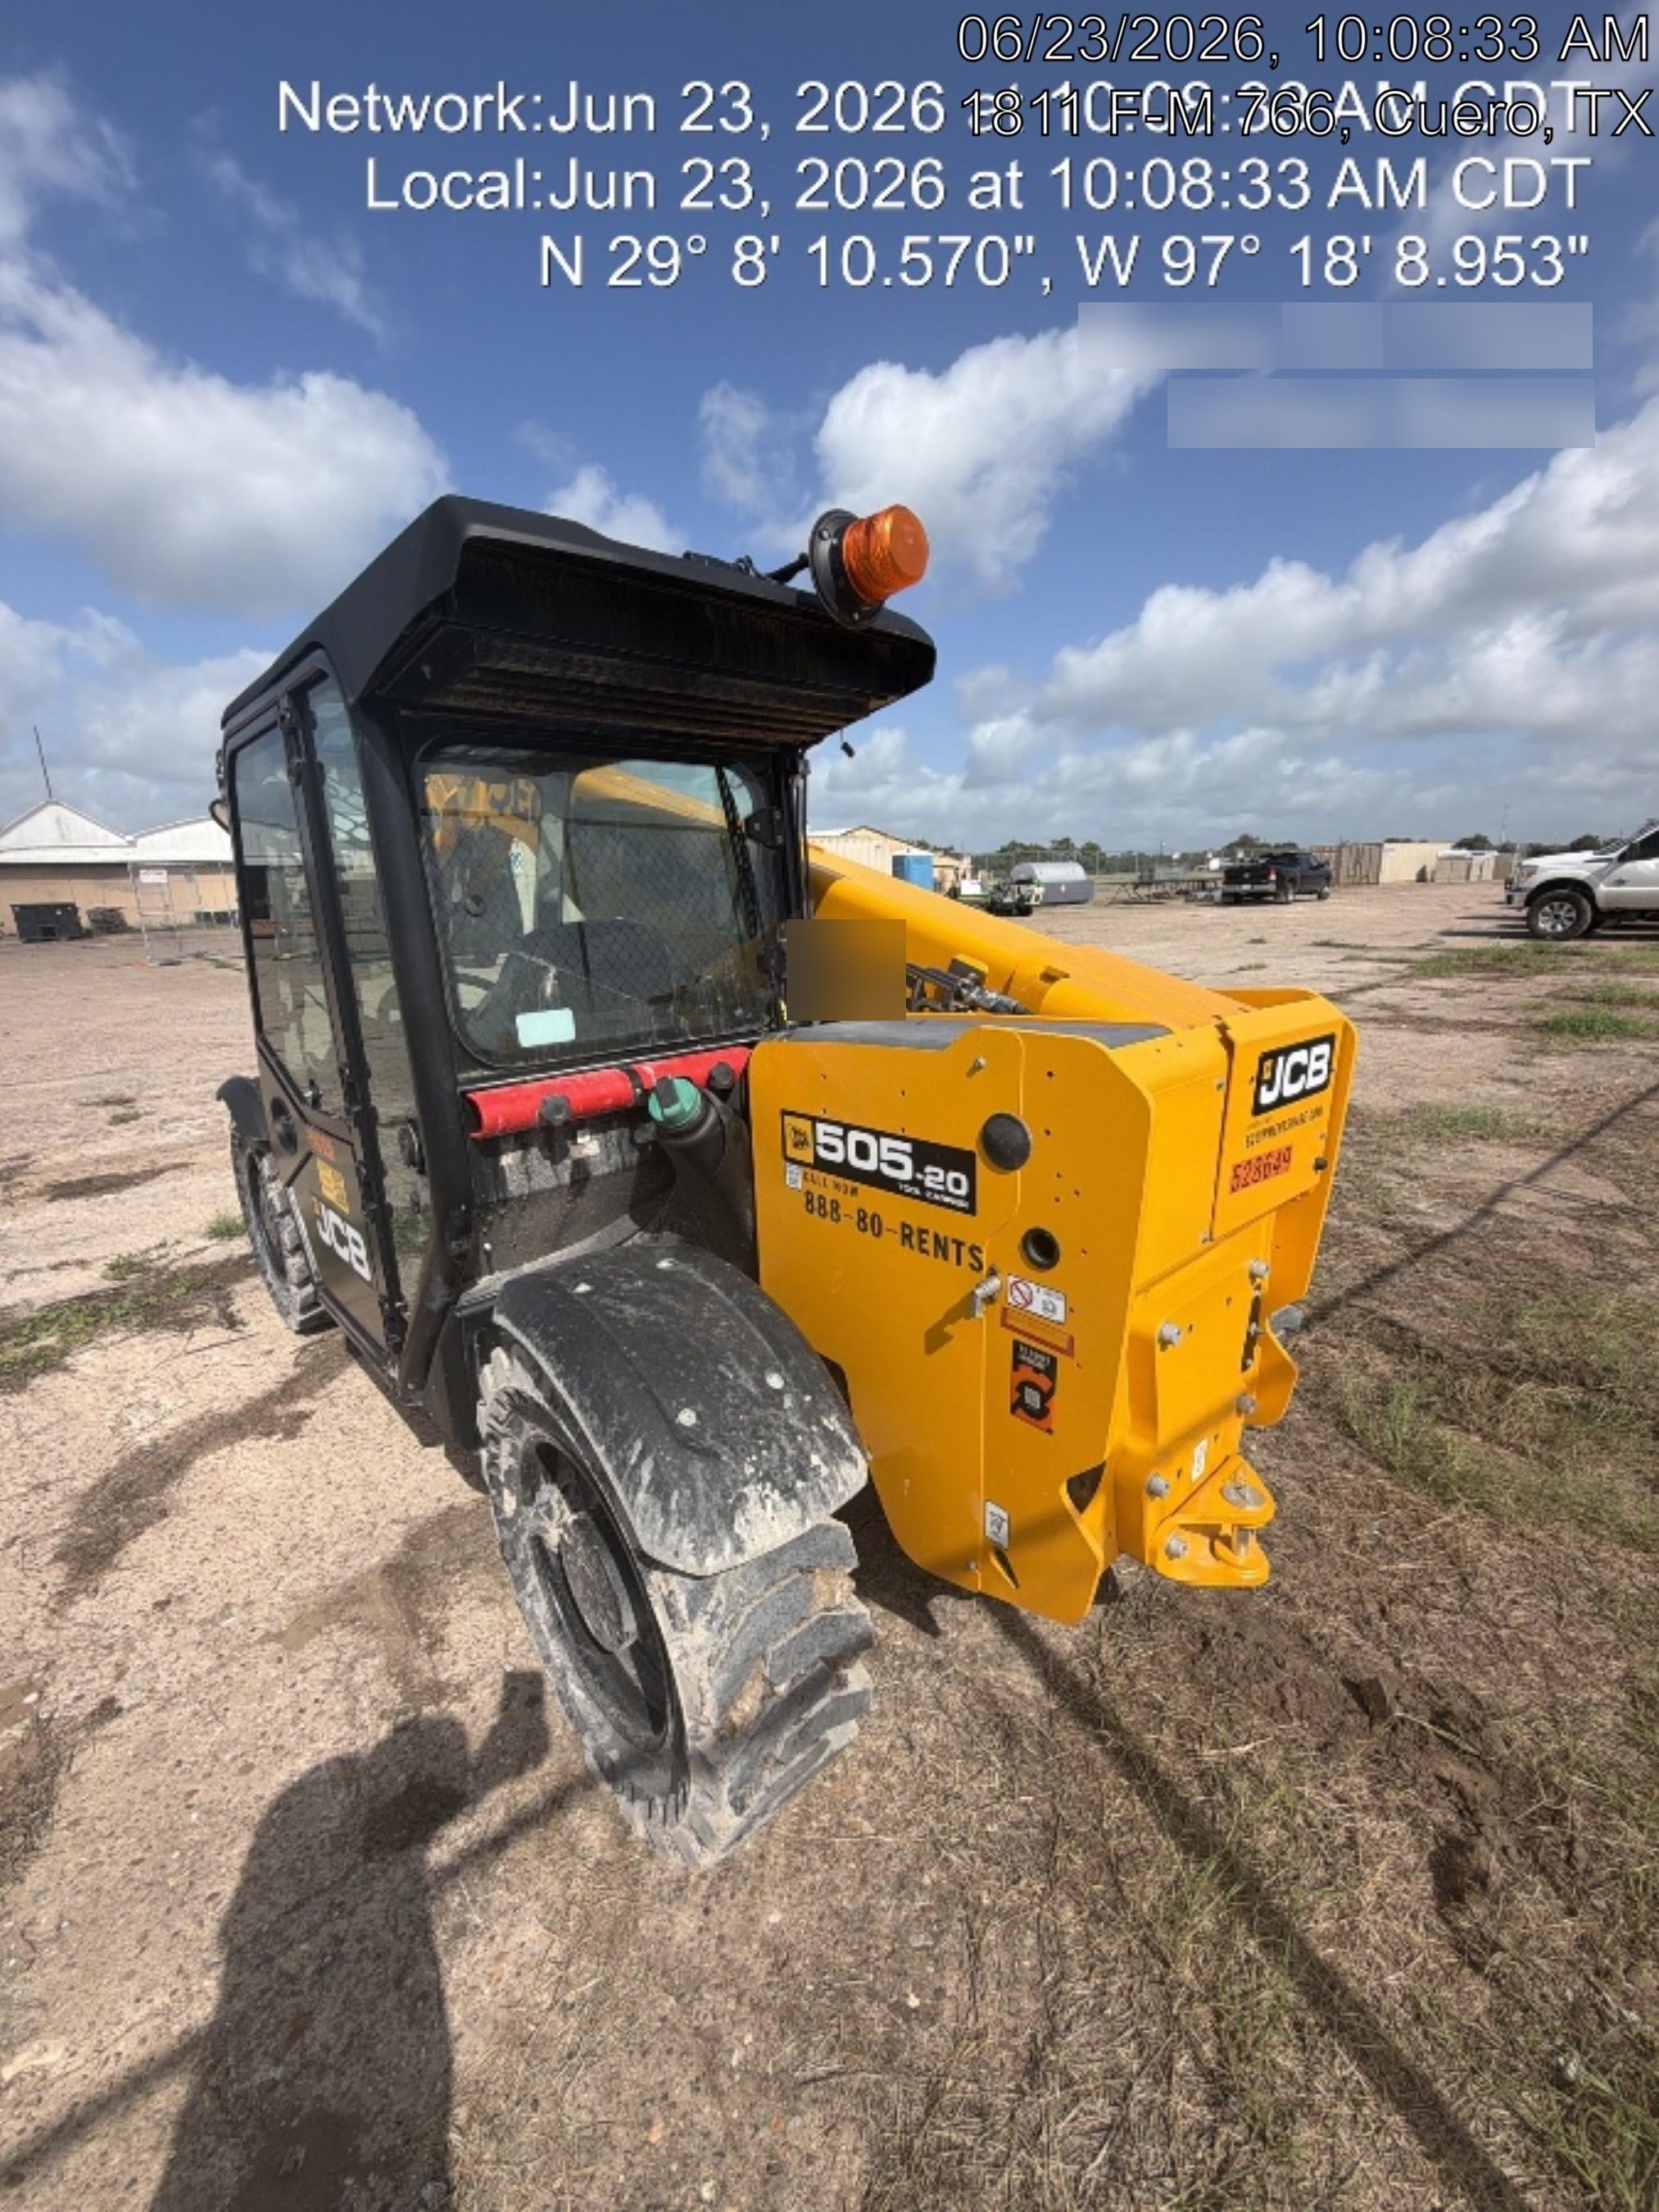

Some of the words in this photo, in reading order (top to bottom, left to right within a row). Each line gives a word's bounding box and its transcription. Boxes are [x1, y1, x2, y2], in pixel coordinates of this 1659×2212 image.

[1259, 1043, 1330, 1105] JCB
[316, 1203, 372, 1281] JCB
[804, 1190, 985, 1273] 888-80-RENTS
